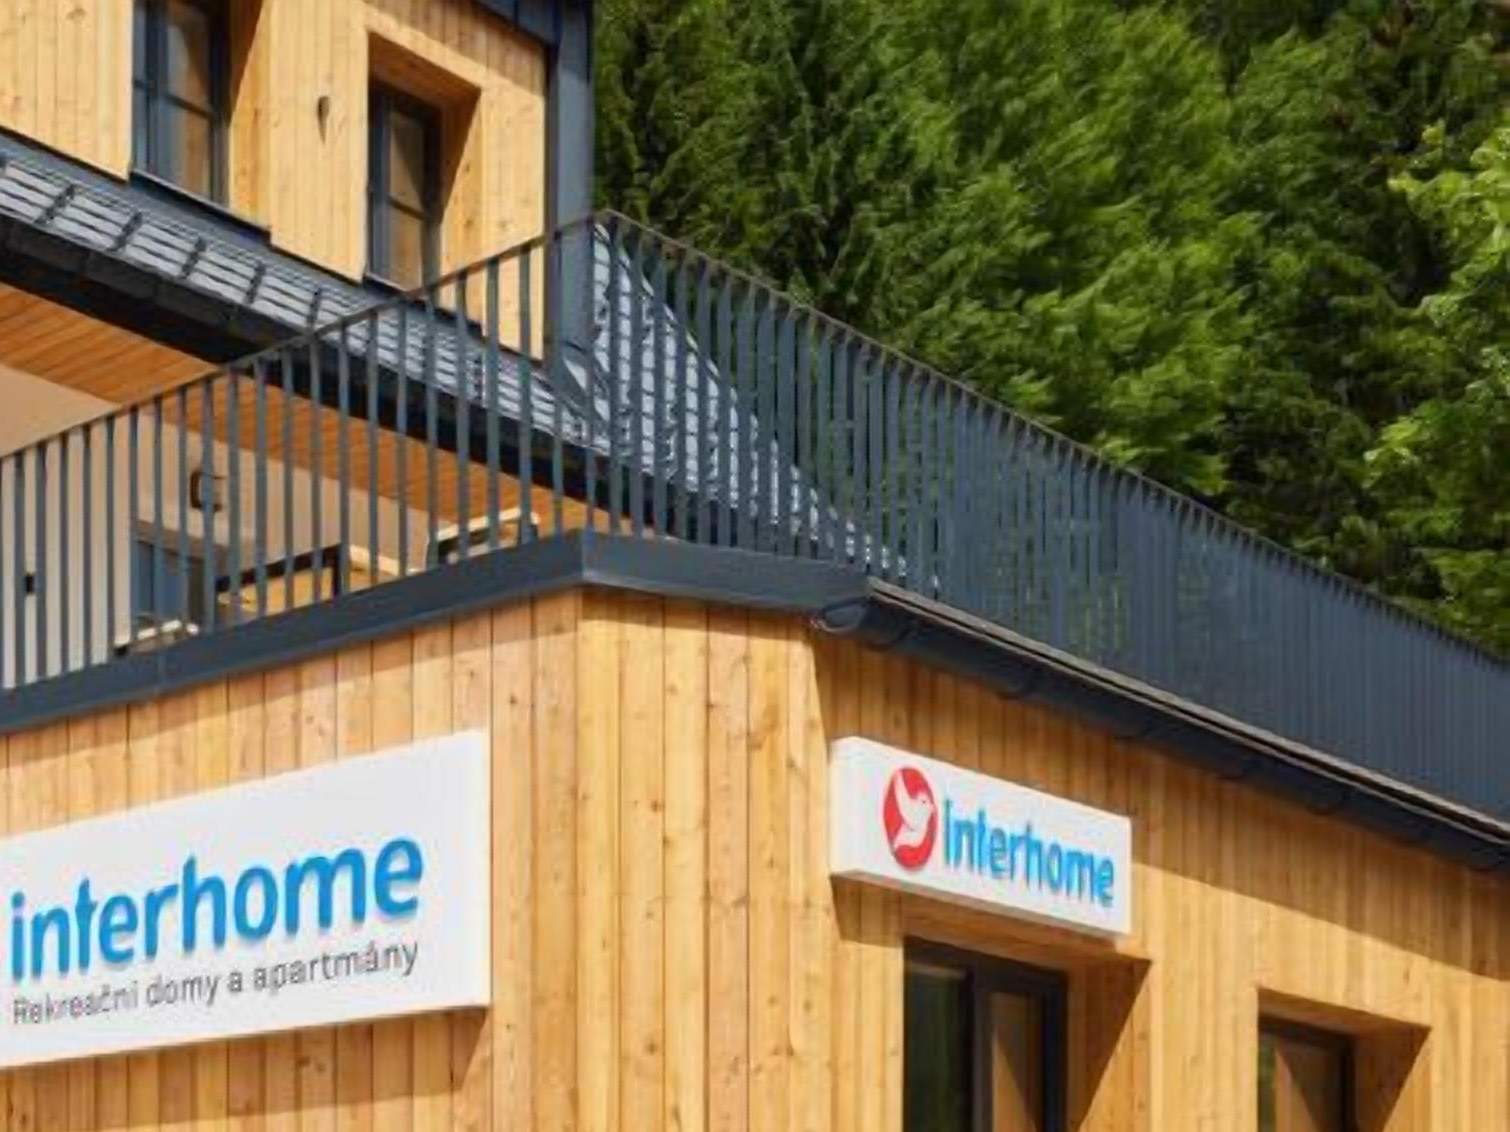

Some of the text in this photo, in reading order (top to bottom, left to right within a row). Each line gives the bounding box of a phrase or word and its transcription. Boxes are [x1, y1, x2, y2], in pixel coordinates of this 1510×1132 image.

[9, 836, 425, 981] interhome
[146, 972, 219, 1006] domy
[227, 971, 243, 992] a
[254, 941, 418, 994] apartmány
